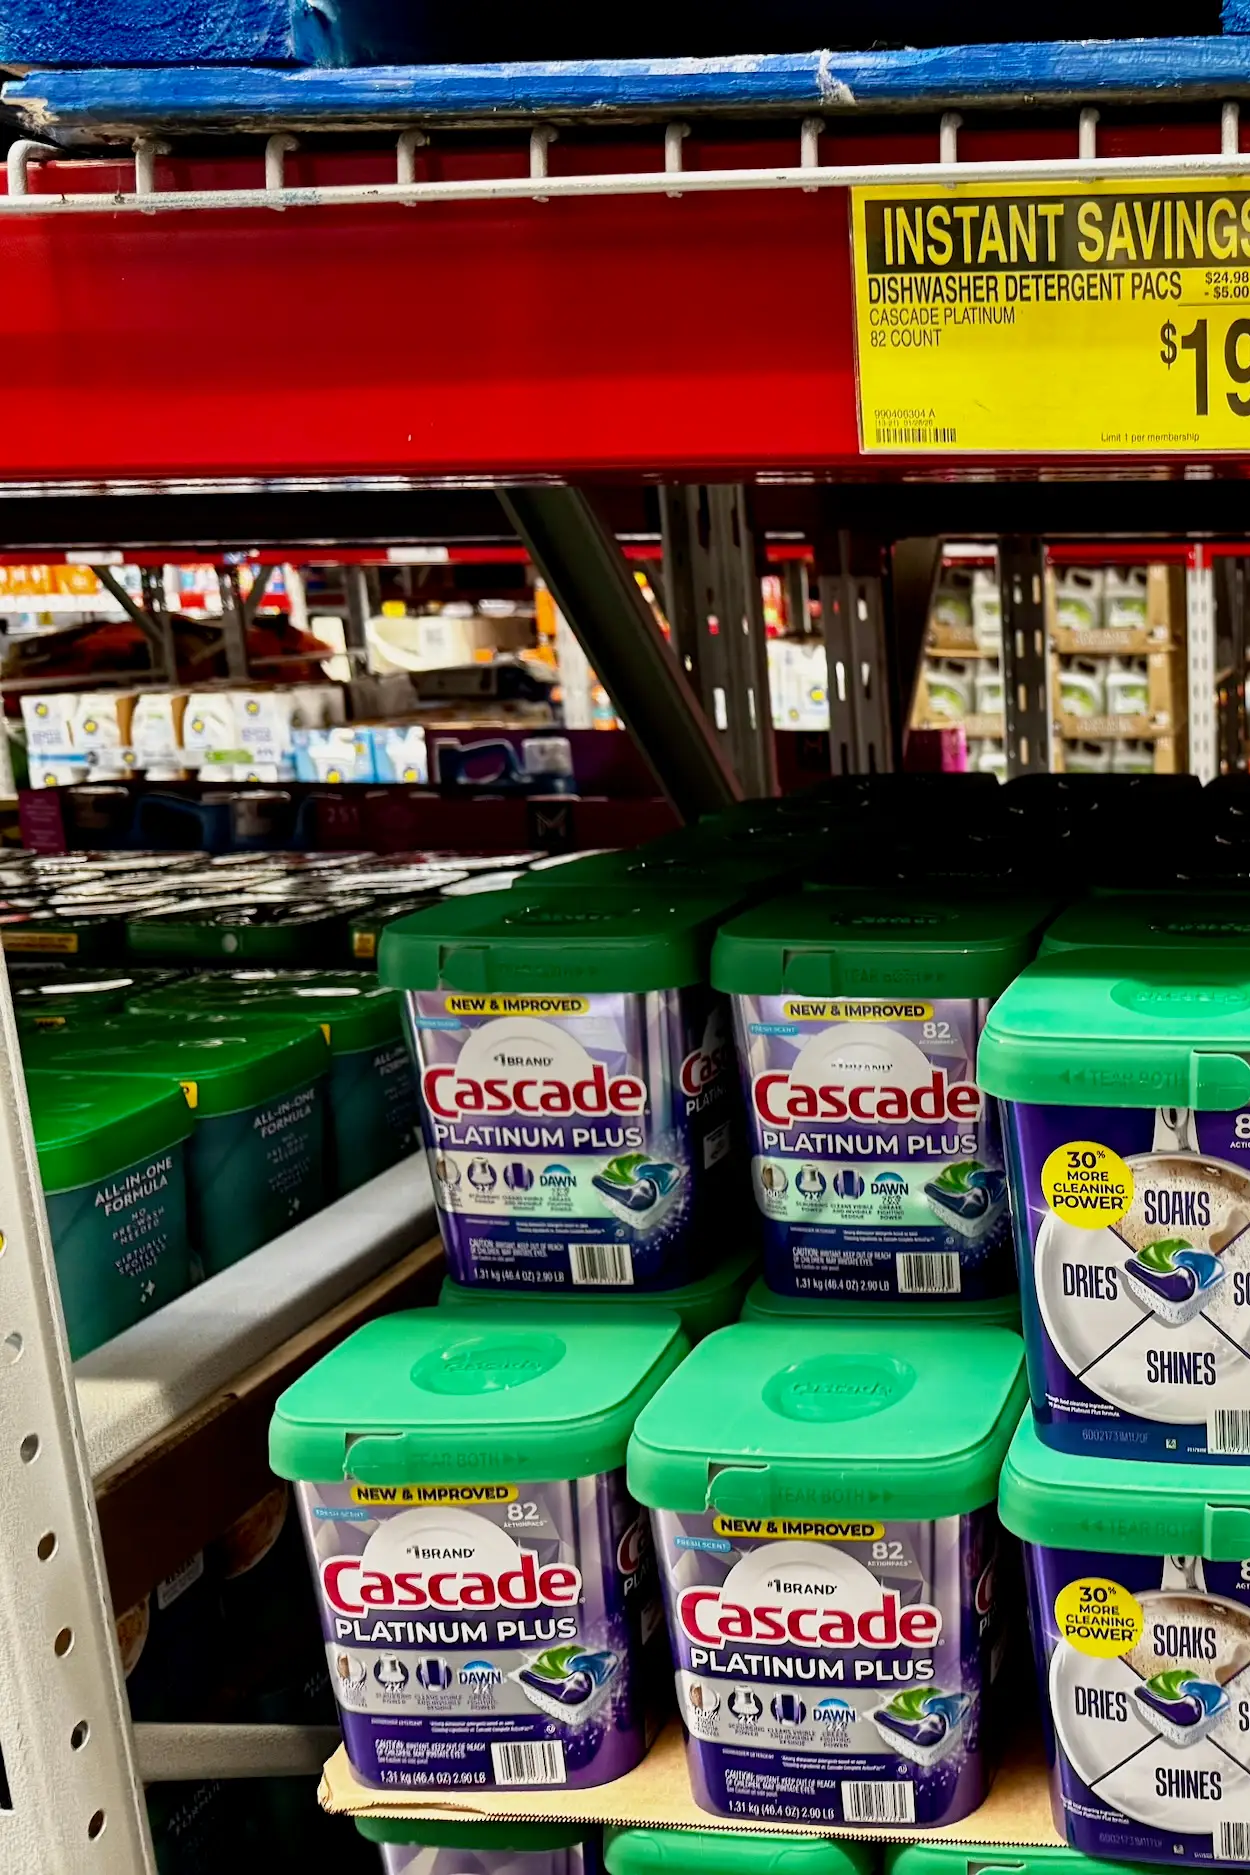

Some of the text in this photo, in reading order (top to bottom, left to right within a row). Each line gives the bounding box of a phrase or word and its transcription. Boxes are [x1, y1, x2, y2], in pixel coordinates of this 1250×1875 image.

[884, 203, 1064, 266] INSTANT
[868, 270, 1183, 305] DISHWASHER DETERGENT PACS
[1205, 271, 1250, 285] $24.98
[1213, 285, 1250, 299] $5.00
[869, 306, 1016, 327] CASCADE PLATINUM
[870, 329, 943, 348] 82 COUNT
[928, 408, 936, 418] A
[1101, 432, 1122, 442] Limit
[1131, 433, 1145, 443] per
[1147, 432, 1200, 443] membership
[451, 999, 583, 1012] NEW & IMPROVED
[790, 1003, 926, 1017] NEW & IMPROVED
[922, 1021, 951, 1039] 82
[422, 1063, 644, 1119] Cascade
[754, 1070, 981, 1126] Cascade
[253, 1087, 315, 1130] ALL-IN-ONE
[260, 1104, 312, 1139] FORMULA
[434, 1123, 644, 1148] PLATINUM PLUS
[763, 1130, 978, 1155] PLATINUM PLUS
[94, 1156, 173, 1207] ALL-IN-ONE
[540, 1175, 577, 1188] DAWN
[1066, 1170, 1109, 1183] MORE
[104, 1174, 169, 1217] FORMULA
[870, 1182, 909, 1196] DAWN
[1052, 1182, 1126, 1196] CLEANING
[1144, 1189, 1211, 1226] SOAKS
[1062, 1262, 1118, 1300] DRIES
[1146, 1349, 1217, 1386] SHINES
[357, 1486, 509, 1501] NEW & IMPROVED
[506, 1502, 540, 1521] 82
[720, 1519, 876, 1537] NEW & IMPROVED
[871, 1541, 905, 1560] 82
[323, 1553, 578, 1615] Cascade
[680, 1591, 939, 1645] Cascade
[1079, 1604, 1120, 1616] MORE
[335, 1616, 578, 1643] PLATINUM PLUS
[1065, 1614, 1136, 1629] CLEANING
[1152, 1624, 1217, 1660] SOAKS
[690, 1649, 936, 1681] PLATINUM PLUS
[458, 1670, 501, 1685] DAWN
[1074, 1686, 1128, 1723] DRIES
[812, 1708, 857, 1724] DAWN
[379, 1769, 400, 1784] 1.31
[400, 1771, 412, 1786] kg
[1155, 1766, 1222, 1801] SHINES
[728, 1800, 746, 1813] 1.31
[748, 1802, 760, 1816] kg
